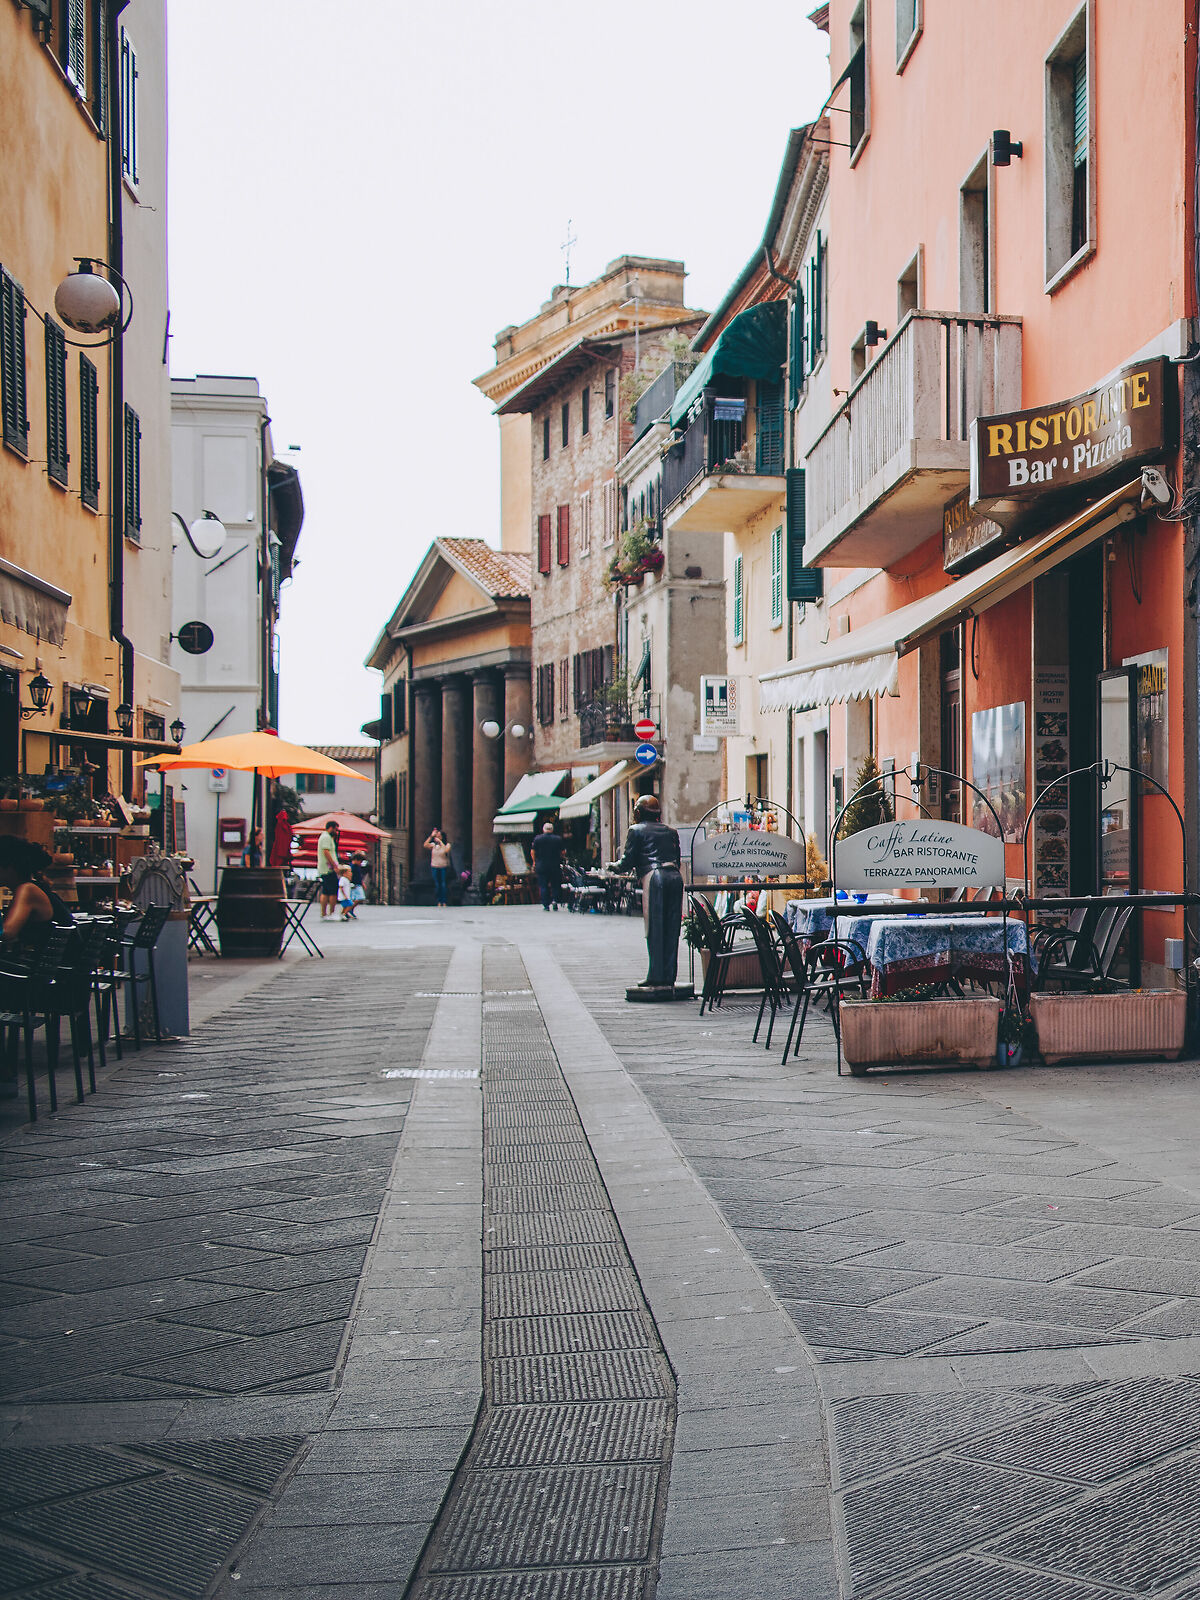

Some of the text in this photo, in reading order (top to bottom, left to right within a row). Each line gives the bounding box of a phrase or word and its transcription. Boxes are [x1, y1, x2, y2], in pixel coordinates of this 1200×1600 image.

[987, 371, 1151, 457] RISTORANTE
[1008, 420, 1133, 487] Bar Pizzeria
[743, 837, 772, 847] Latino
[867, 823, 954, 864] Caffè Latino
[746, 848, 788, 860] RISTORANTE
[893, 847, 979, 864] BAR RISTORANTE
[863, 866, 978, 877] TERRAZZA PANORAMICA
